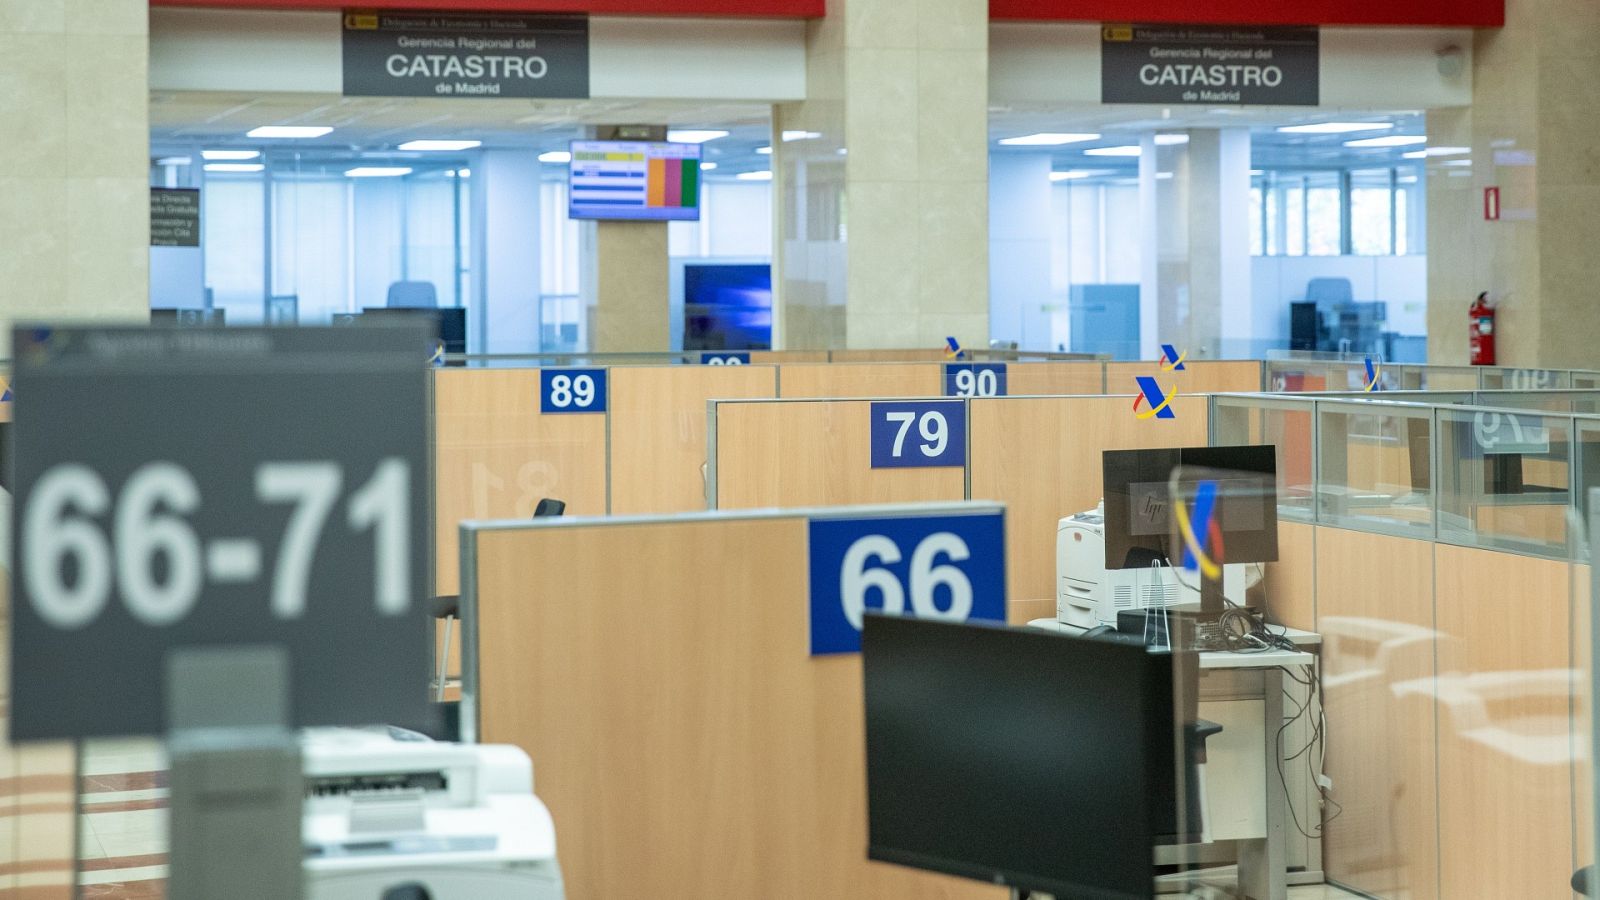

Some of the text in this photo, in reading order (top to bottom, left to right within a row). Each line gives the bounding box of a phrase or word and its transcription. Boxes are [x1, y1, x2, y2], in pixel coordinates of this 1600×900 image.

[397, 36, 536, 51] Gerencia Regional del
[1149, 47, 1273, 61] Gerencia Regional del
[386, 54, 548, 78] CATASTRO
[1139, 64, 1282, 87] CATASTRO
[435, 82, 500, 94] de Madrid
[1182, 90, 1240, 101] de Madrid
[551, 374, 595, 407] 89
[955, 369, 997, 397] 90
[886, 410, 949, 457] 79
[21, 456, 413, 629] 66-71
[840, 531, 973, 632] 66
